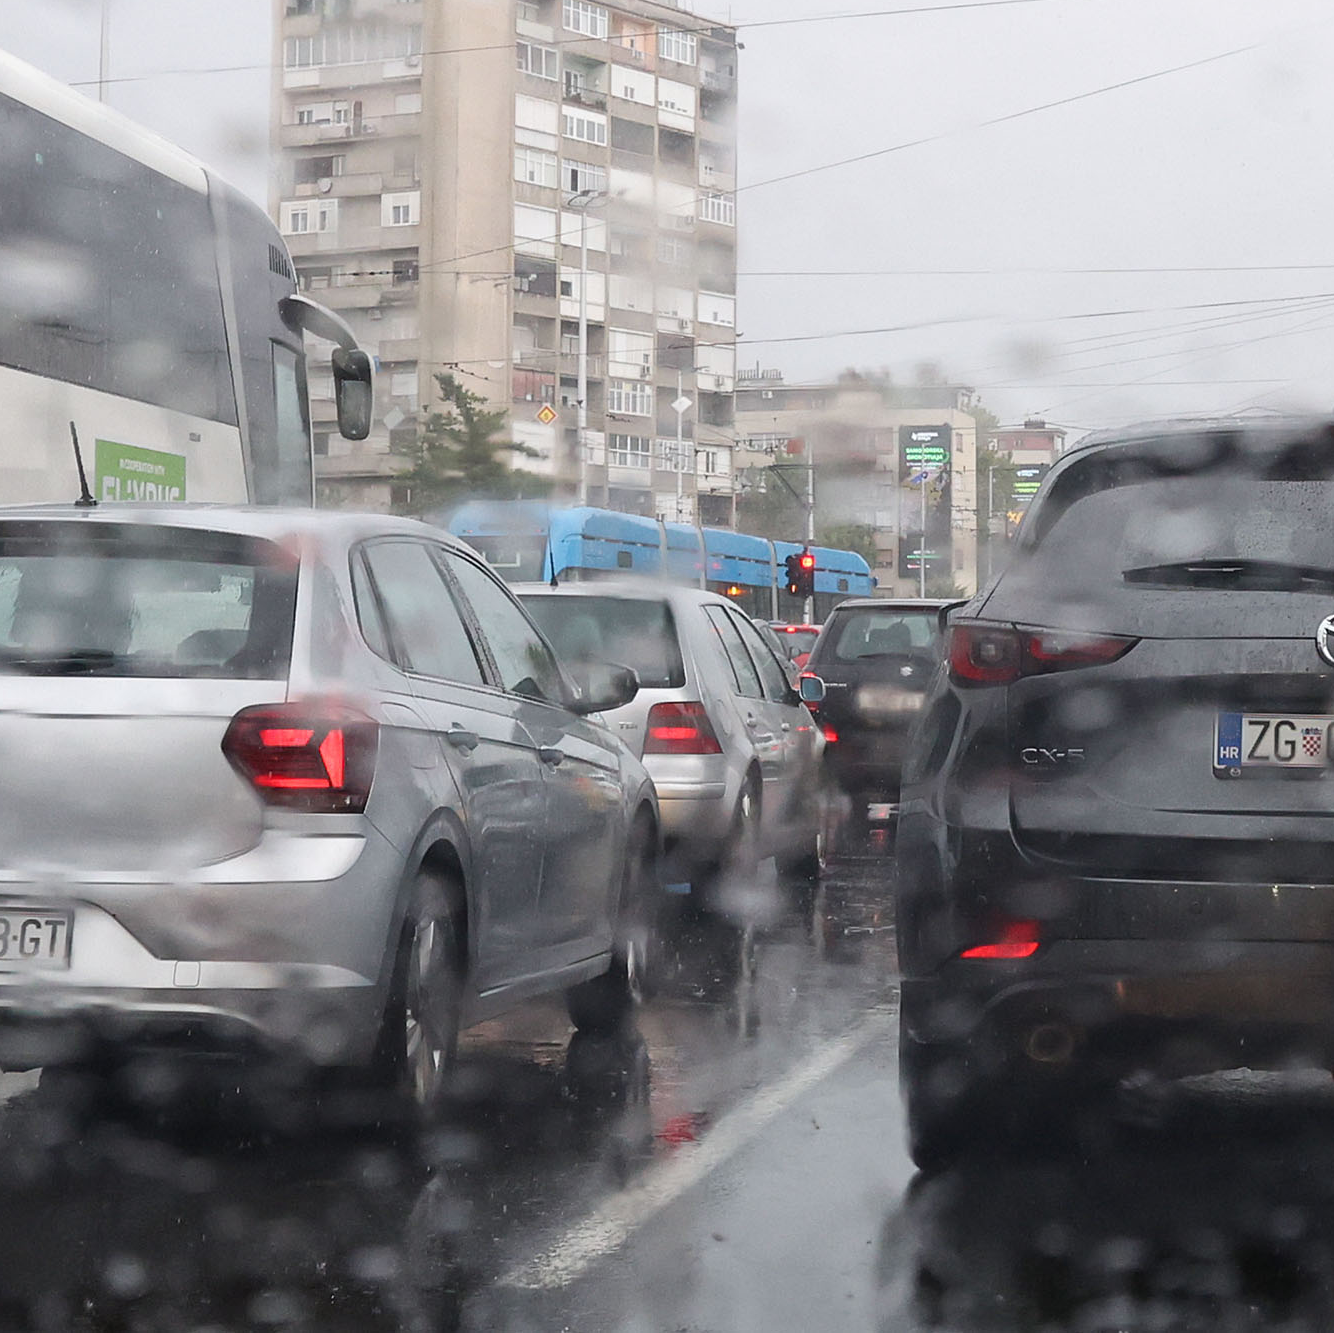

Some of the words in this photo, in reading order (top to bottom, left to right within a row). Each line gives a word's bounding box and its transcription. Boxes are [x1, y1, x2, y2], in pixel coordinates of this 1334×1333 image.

[1247, 719, 1296, 762] ZG
[1021, 747, 1085, 764] CX-5
[1219, 746, 1239, 759] HR
